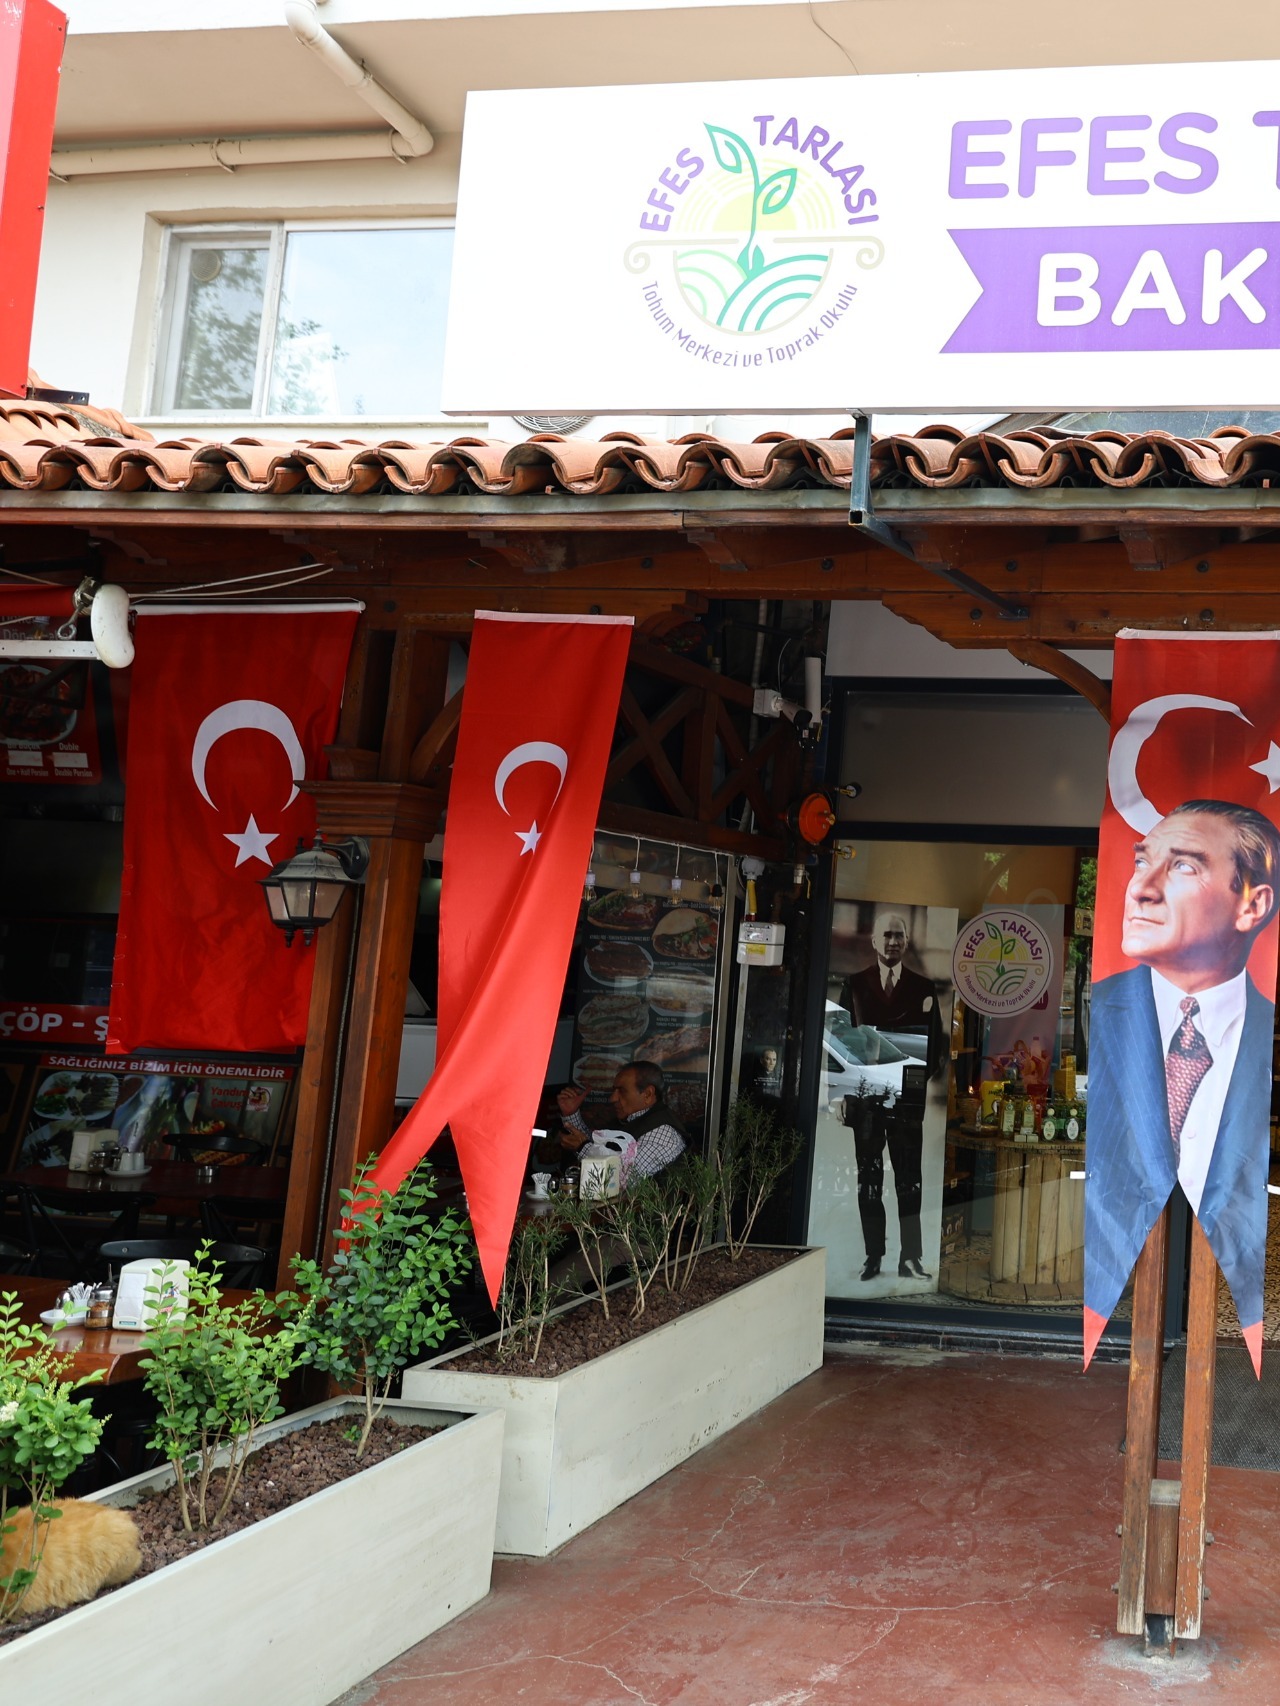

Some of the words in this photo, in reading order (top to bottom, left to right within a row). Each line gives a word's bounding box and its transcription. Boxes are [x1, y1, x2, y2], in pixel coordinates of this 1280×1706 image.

[639, 147, 705, 232] EFES
[753, 115, 879, 225] TARLASI
[947, 112, 1219, 199] EFES
[642, 280, 675, 334] Tohum
[672, 327, 738, 367] Merkezi
[742, 353, 763, 368] ve
[766, 330, 824, 365] Toprak
[819, 283, 858, 330] Okulu
[963, 929, 985, 959] EFES
[1000, 919, 1043, 961] TARLASI
[964, 974, 976, 994] Tohum
[975, 991, 997, 1008] Merkezi
[1005, 993, 1025, 1007] Toprak
[48, 1055, 127, 1071] SAĞLIĞINIZ
[129, 1060, 171, 1073] BİZİM
[173, 1062, 205, 1076] İÇİN
[207, 1062, 285, 1079] ÖNEMLİDİR
